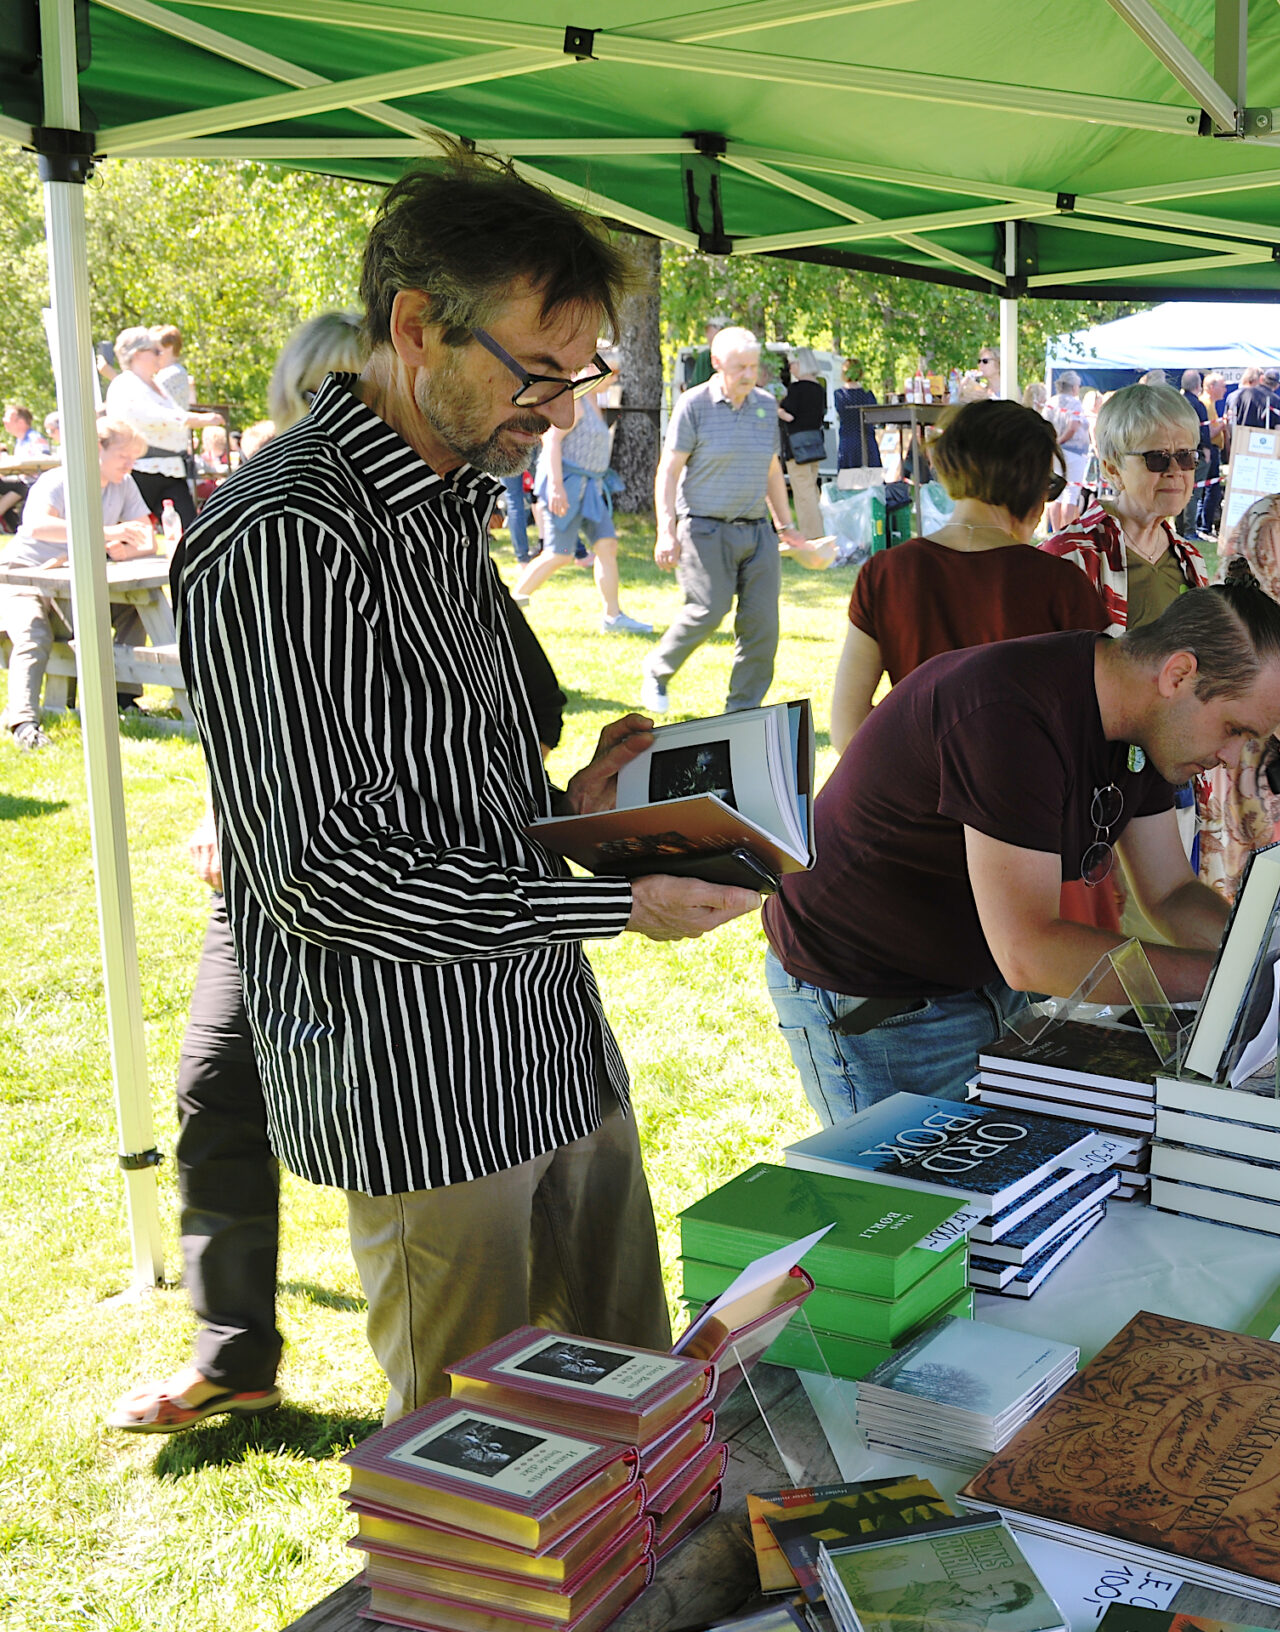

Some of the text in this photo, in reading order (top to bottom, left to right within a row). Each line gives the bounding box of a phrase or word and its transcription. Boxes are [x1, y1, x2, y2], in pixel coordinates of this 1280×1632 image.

[858, 1111, 982, 1163] BOK
[921, 1122, 1029, 1174] ORD
[858, 1211, 900, 1241] BØRLI
[892, 1212, 915, 1230] HANS
[551, 1450, 579, 1466] Hans
[965, 1530, 1014, 1571] HANS
[1138, 1571, 1173, 1592] E
